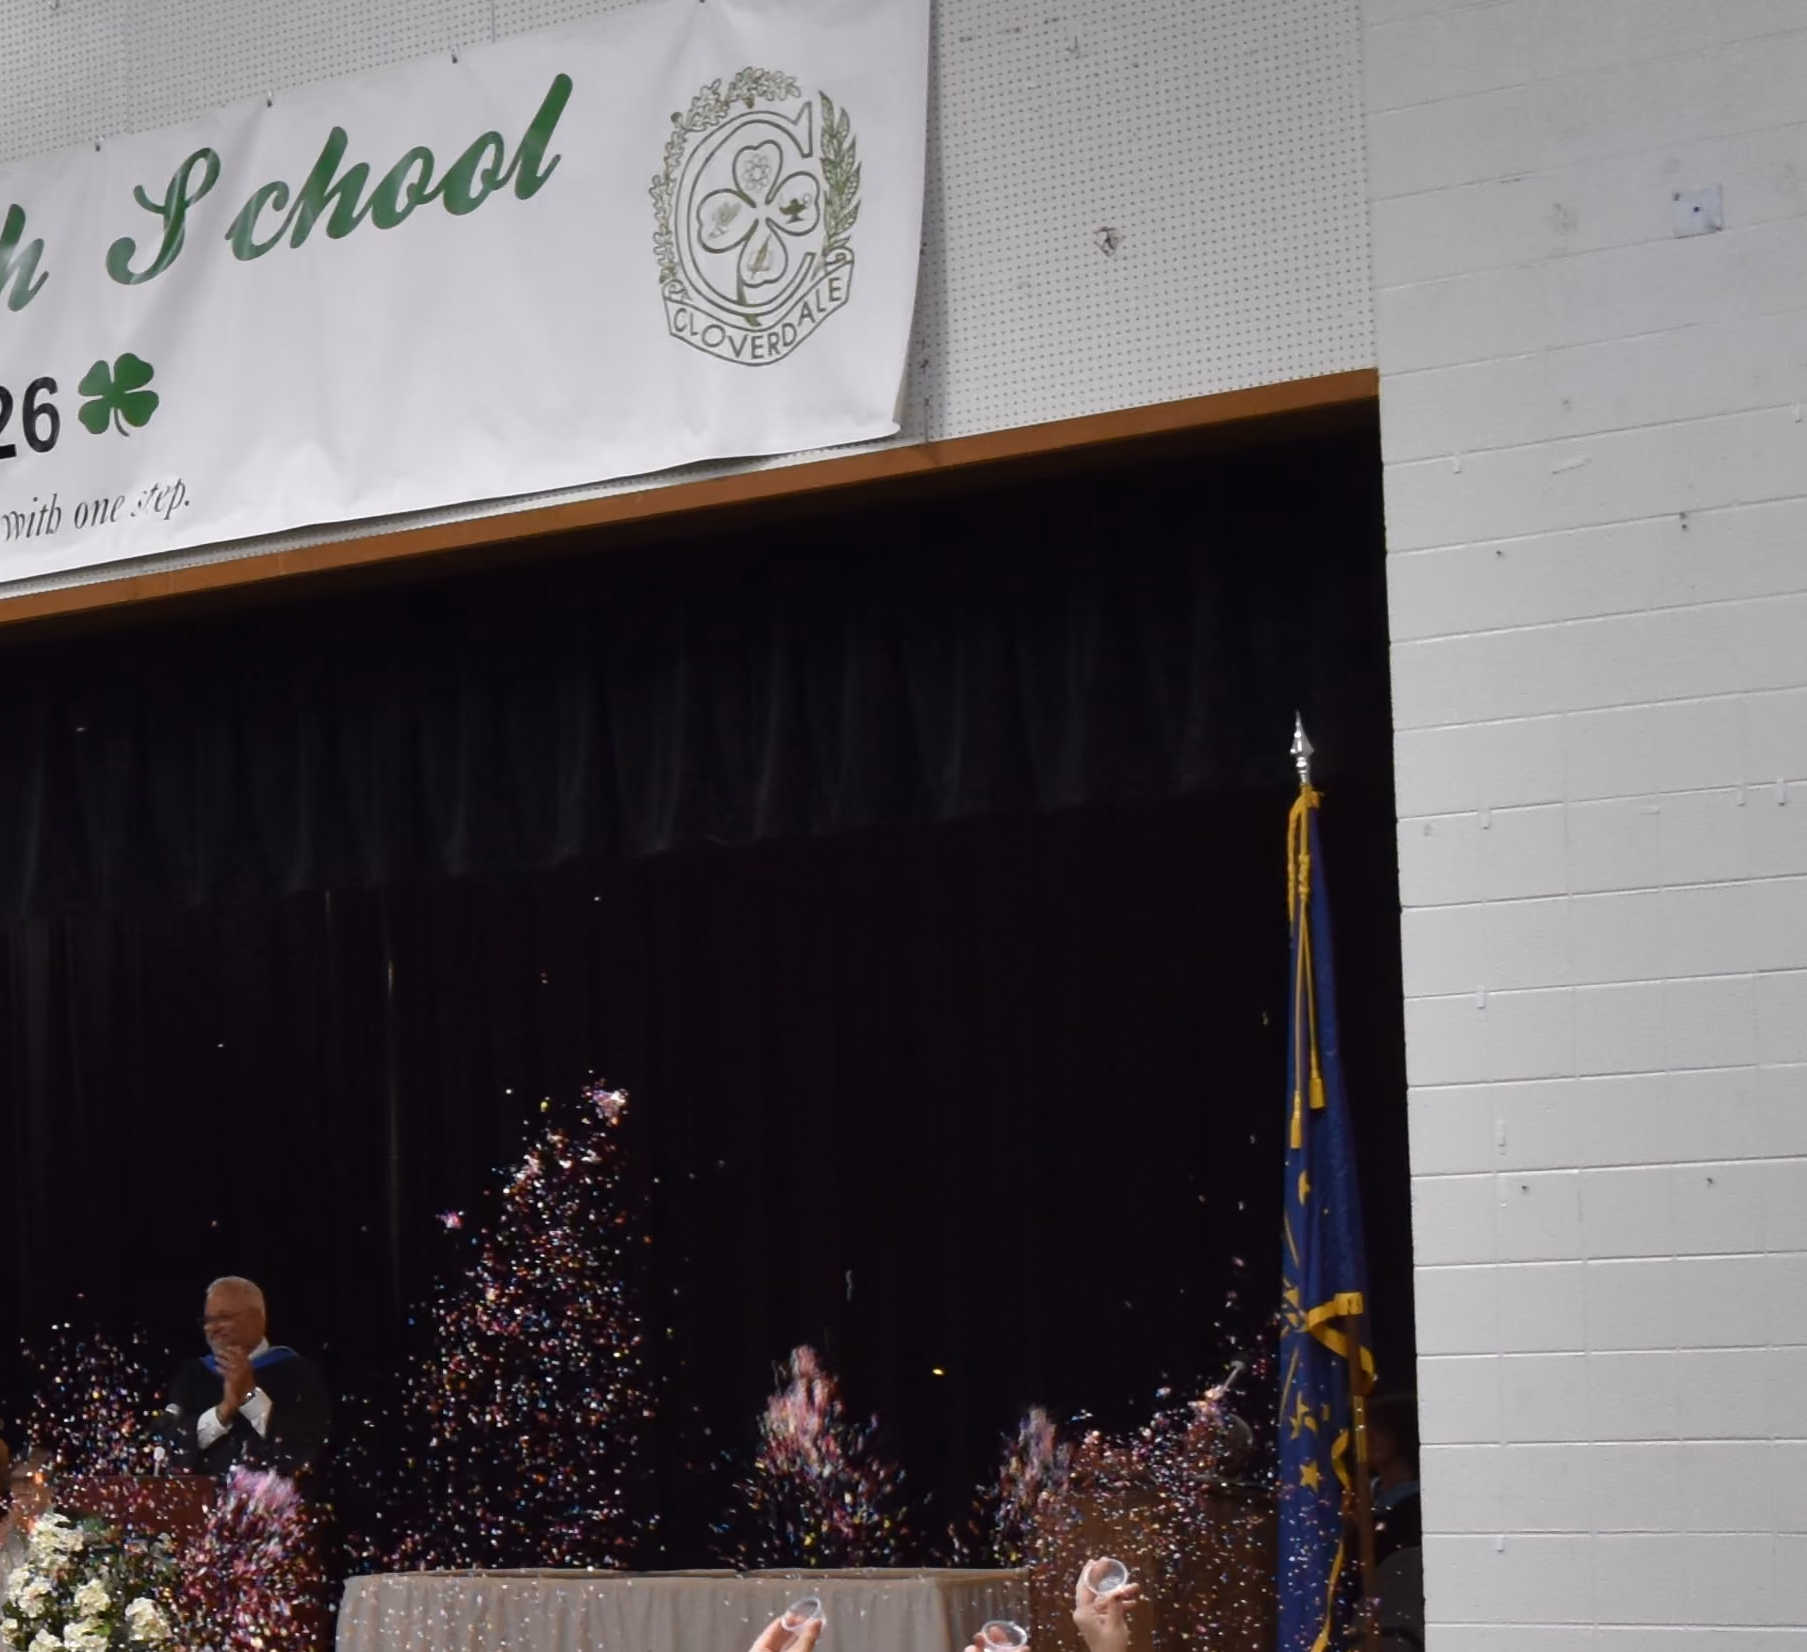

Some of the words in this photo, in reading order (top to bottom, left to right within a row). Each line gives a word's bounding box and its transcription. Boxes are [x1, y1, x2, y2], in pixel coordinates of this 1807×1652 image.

[105, 73, 574, 286] School
[673, 276, 843, 360] CLOVERDALE
[1, 493, 63, 543] with
[73, 492, 126, 531] one
